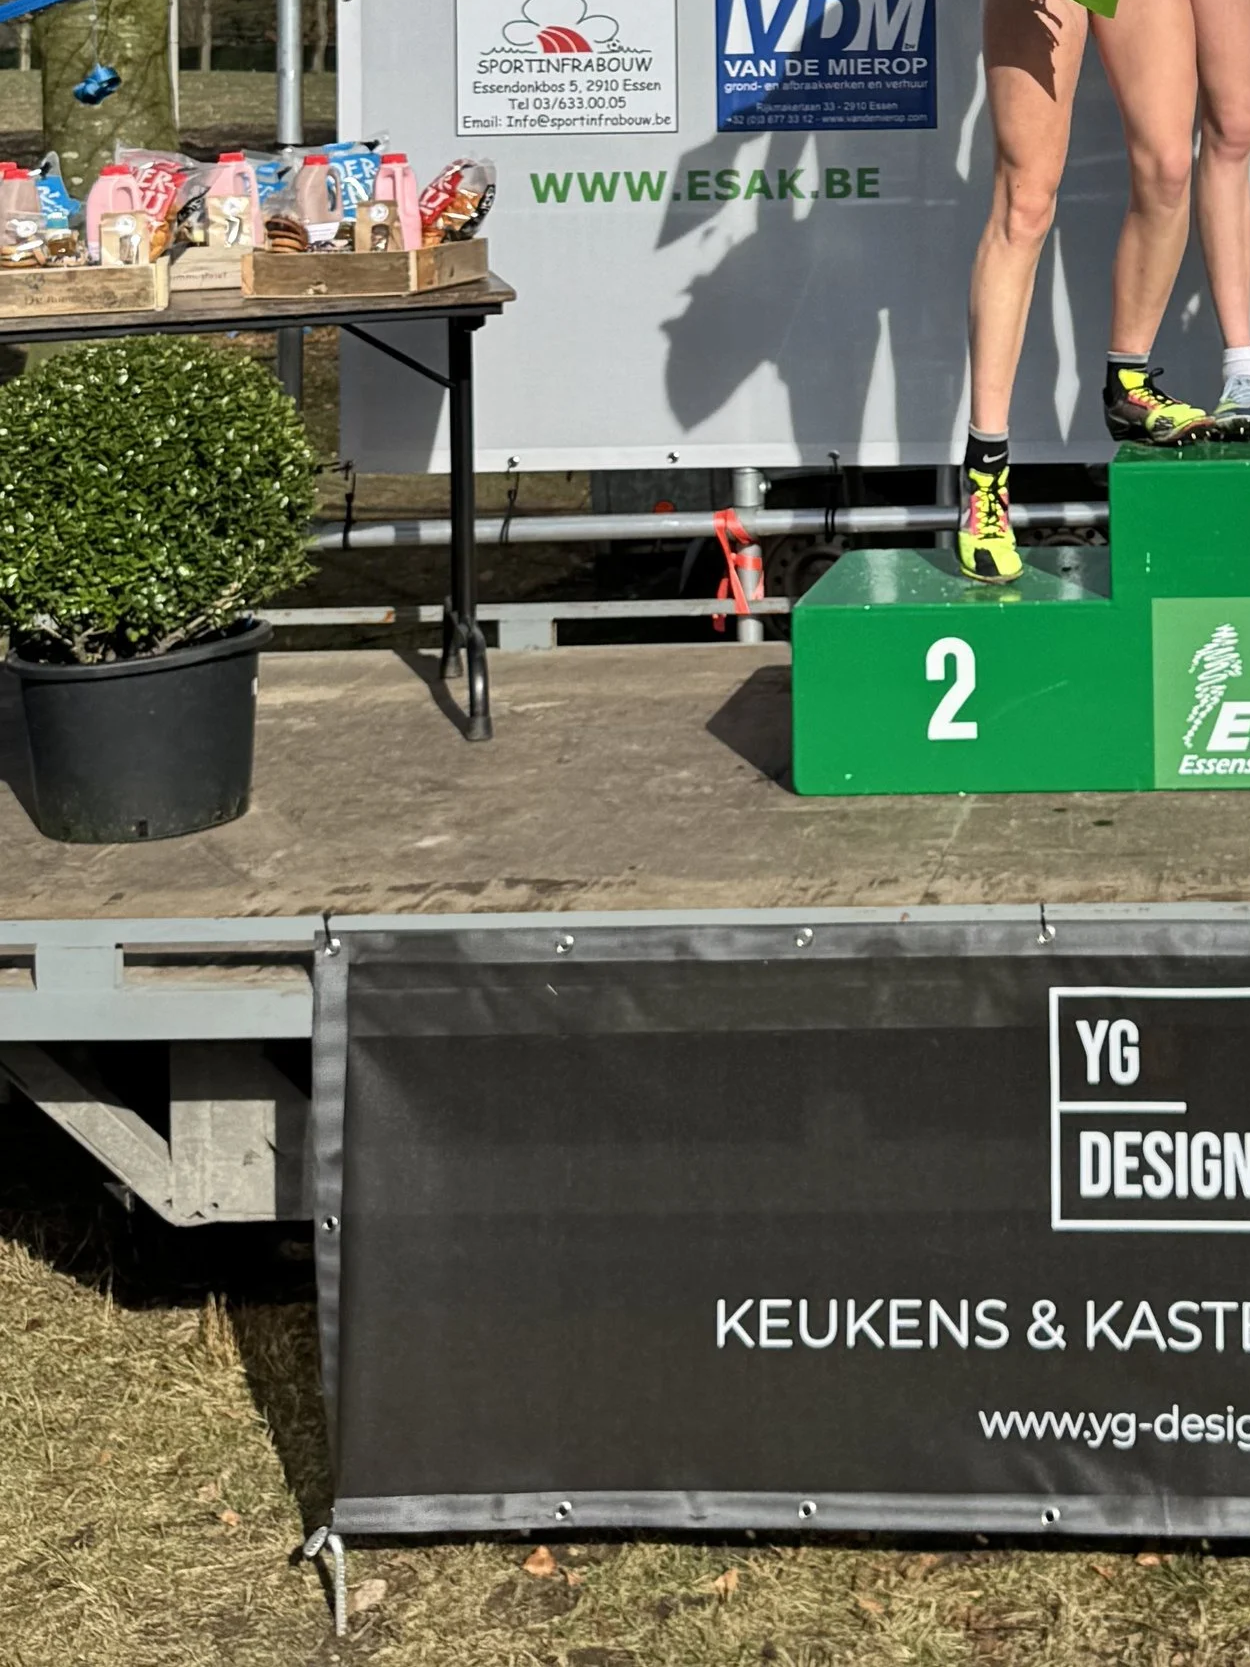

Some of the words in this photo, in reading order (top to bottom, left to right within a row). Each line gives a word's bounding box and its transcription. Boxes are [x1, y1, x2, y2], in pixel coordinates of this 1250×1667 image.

[477, 57, 653, 74] SPORTINFRABOUW
[724, 59, 777, 77] VAN
[785, 59, 819, 77] DE
[828, 57, 928, 76] MIEROP
[473, 81, 565, 94] Essendonkbos
[570, 81, 582, 94] 5,
[586, 80, 619, 91] 2910
[623, 79, 661, 91] Essen
[724, 83, 762, 93] grond-
[764, 83, 779, 91] en
[509, 98, 529, 110] Tel
[463, 116, 502, 129] Email:
[506, 113, 671, 130] Info@sportinfrabouw.be
[530, 168, 880, 204] WWW.ESAK.BE
[925, 636, 978, 742] 2
[1075, 1019, 1140, 1085] YG
[716, 1298, 1010, 1350] KEUKENS
[1027, 1299, 1067, 1351] &
